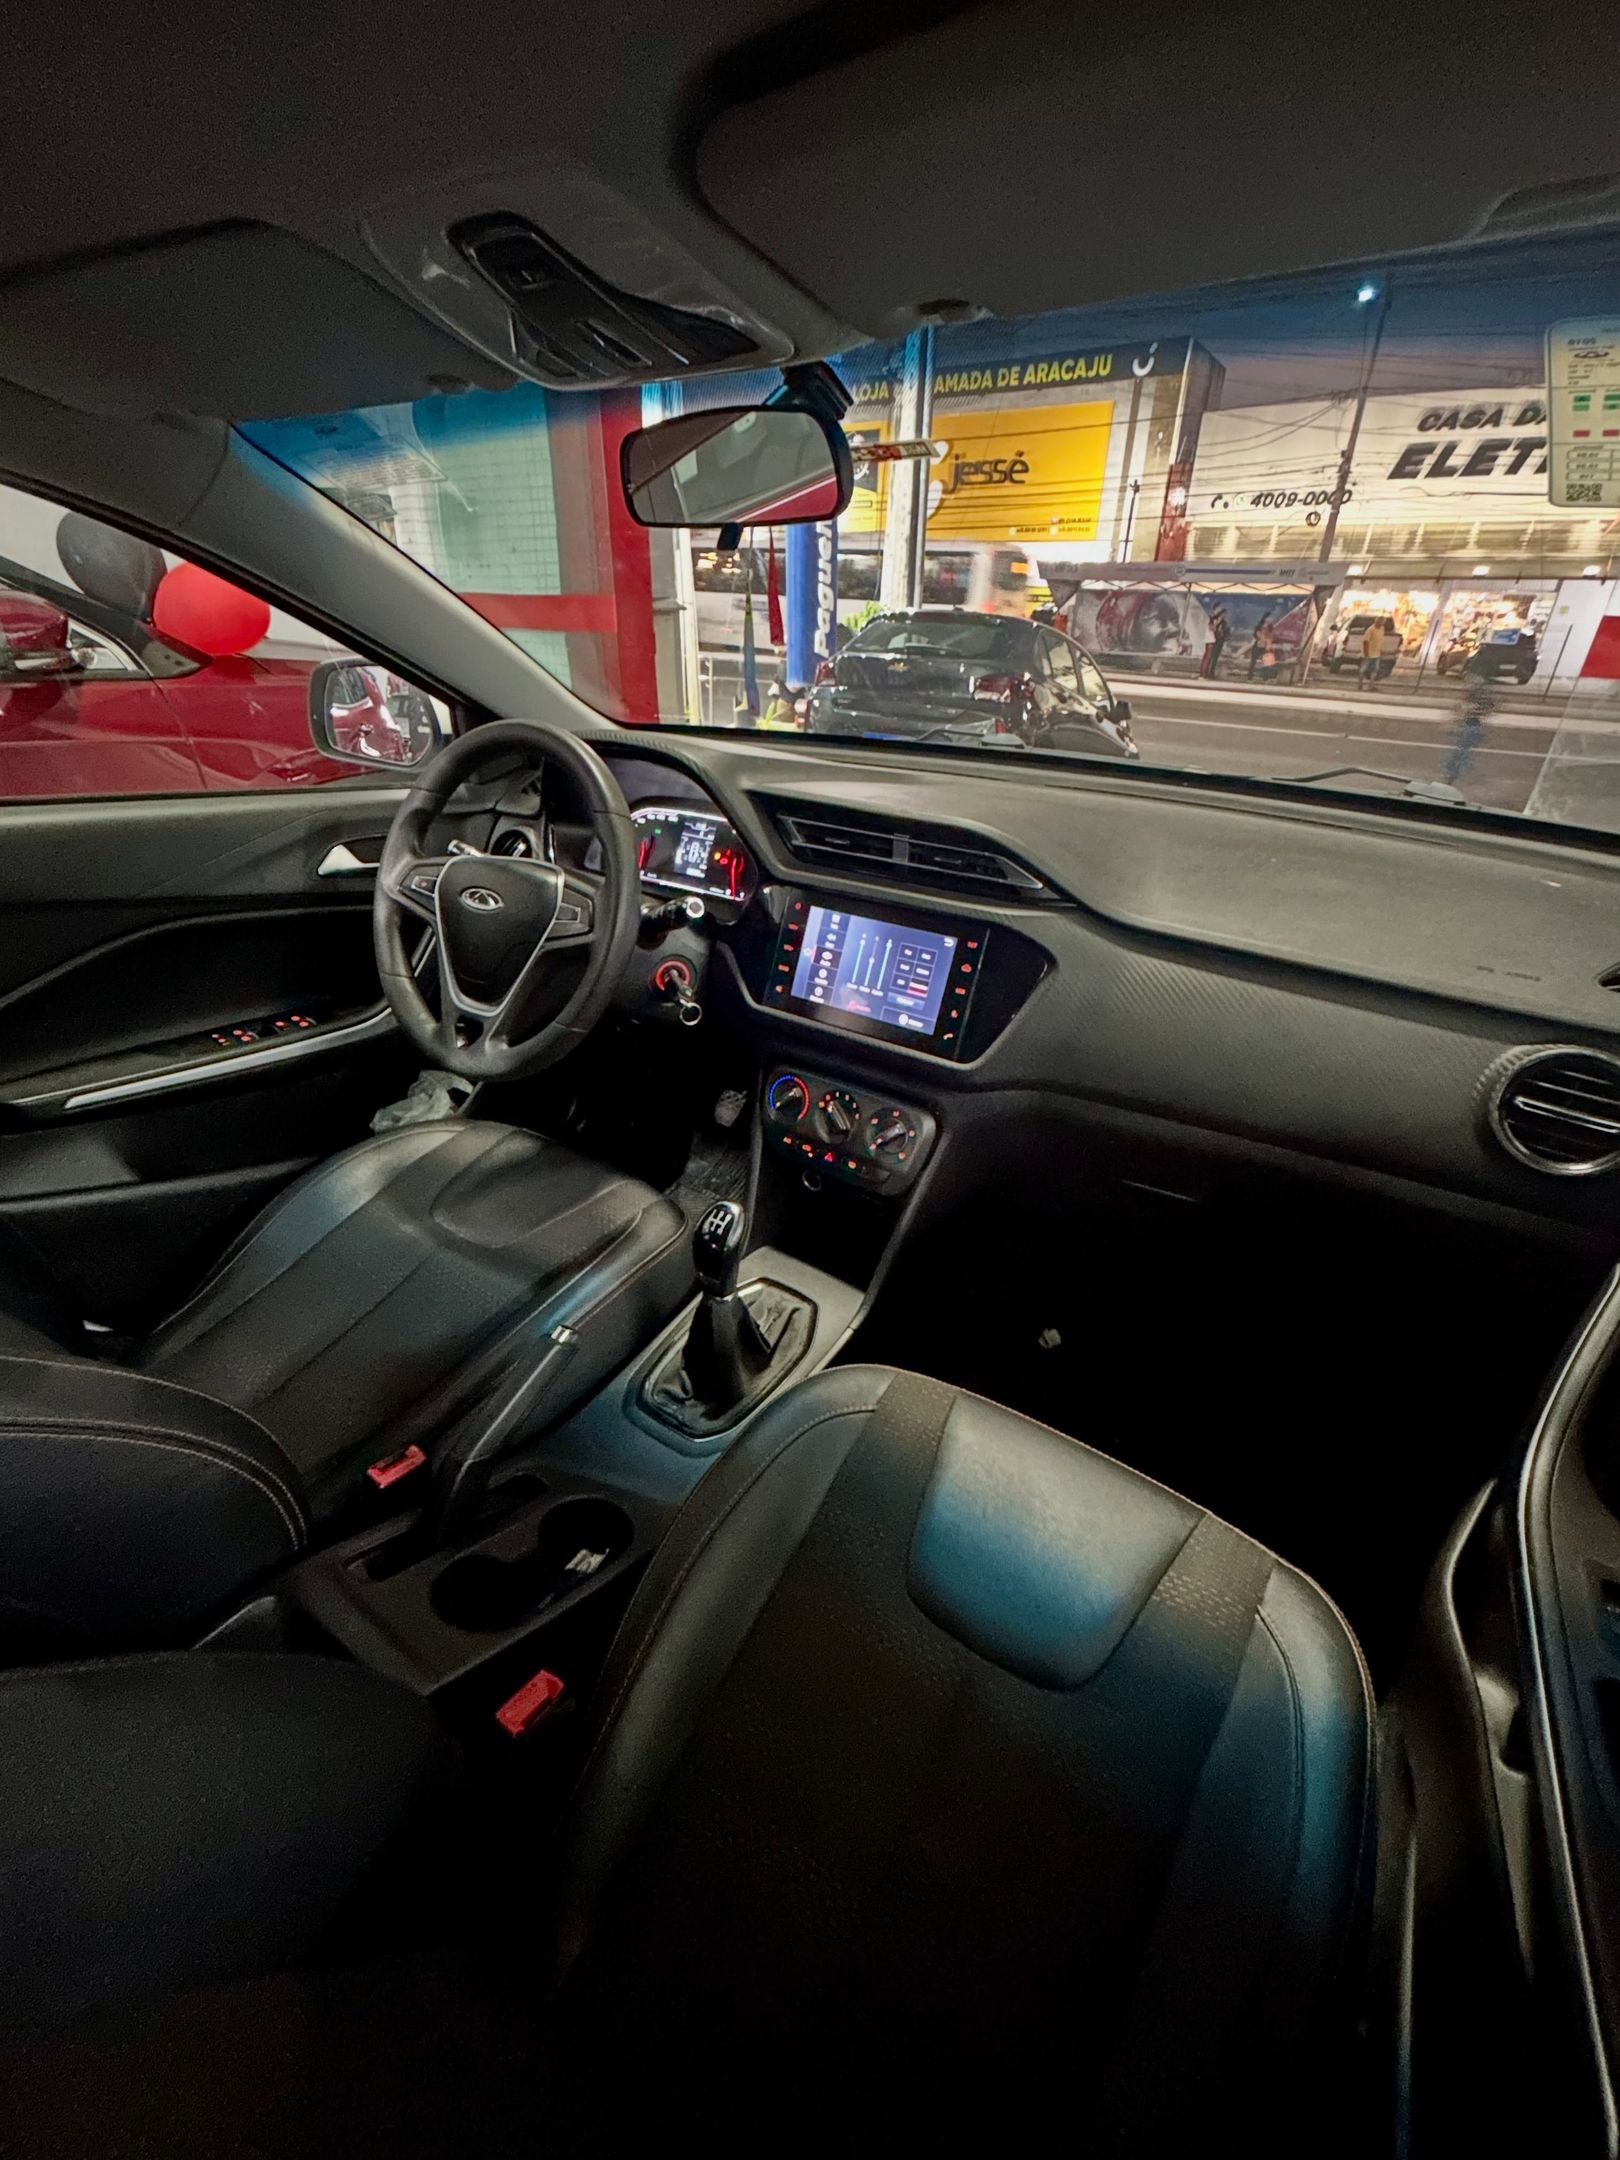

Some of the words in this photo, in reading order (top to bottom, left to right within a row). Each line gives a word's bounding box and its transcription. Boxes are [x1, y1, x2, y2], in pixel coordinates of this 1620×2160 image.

[934, 373, 992, 393] AMADA
[997, 366, 1019, 388] DE
[1023, 354, 1113, 385] ARACAJU
[1417, 404, 1503, 432] CASA
[946, 451, 1029, 494] jessé
[1386, 437, 1547, 480] ELET
